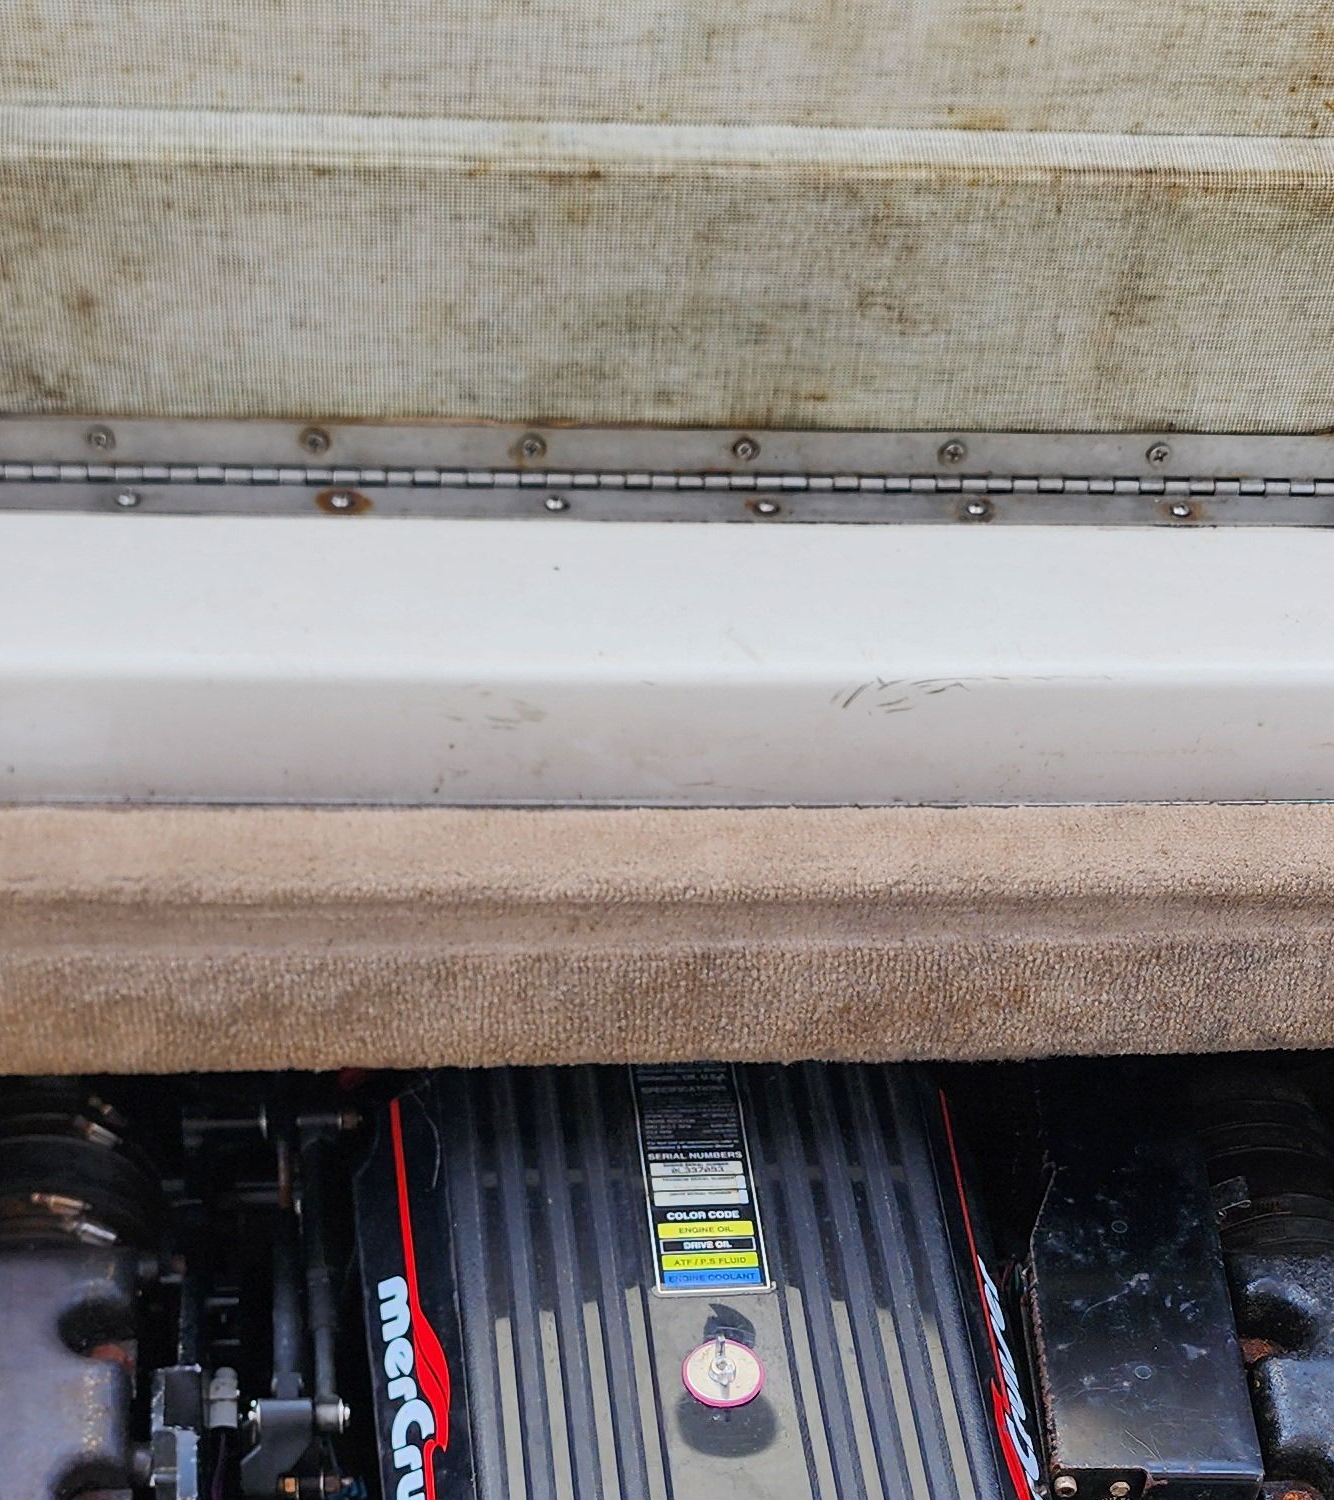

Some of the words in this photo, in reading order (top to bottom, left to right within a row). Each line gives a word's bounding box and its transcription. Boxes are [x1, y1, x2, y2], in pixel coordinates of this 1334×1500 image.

[648, 1152, 687, 1160] SERIAL
[689, 1151, 742, 1159] NUMBERS
[666, 1211, 706, 1220] COLOR
[708, 1210, 740, 1219] CODE
[679, 1226, 715, 1234] ENGINE
[683, 1241, 714, 1250] DRIVE
[715, 1240, 732, 1249] OIL
[674, 1258, 693, 1266] ATF
[718, 1256, 746, 1264] FLUID
[668, 1274, 705, 1283] ENGINE
[708, 1272, 755, 1281] COOLANT
